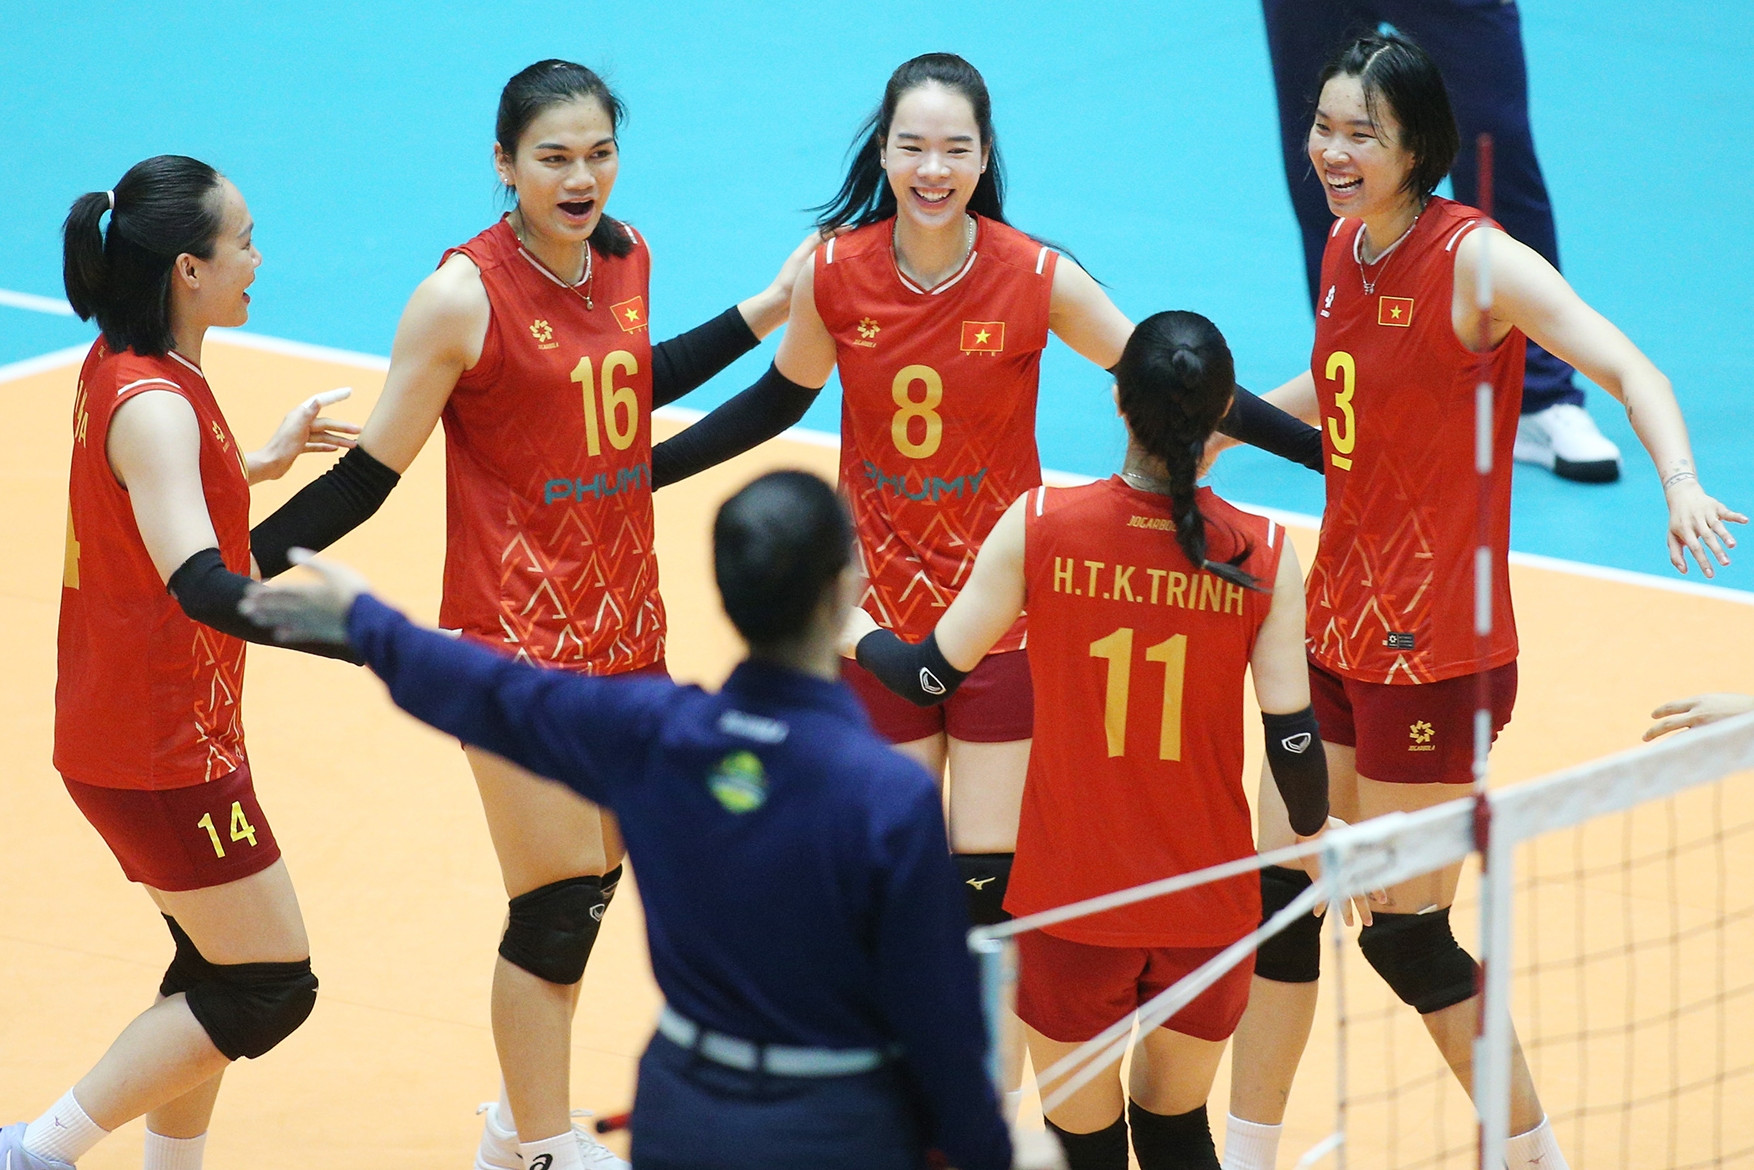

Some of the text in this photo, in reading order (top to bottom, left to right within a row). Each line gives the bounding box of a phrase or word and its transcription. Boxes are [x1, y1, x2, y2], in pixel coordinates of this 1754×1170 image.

[570, 350, 639, 456] 16
[891, 364, 943, 459] 8
[1325, 351, 1356, 455] 3
[1053, 556, 1244, 616] H.T.K.TRINH
[1089, 627, 1188, 762] 11
[197, 800, 258, 858] 14
